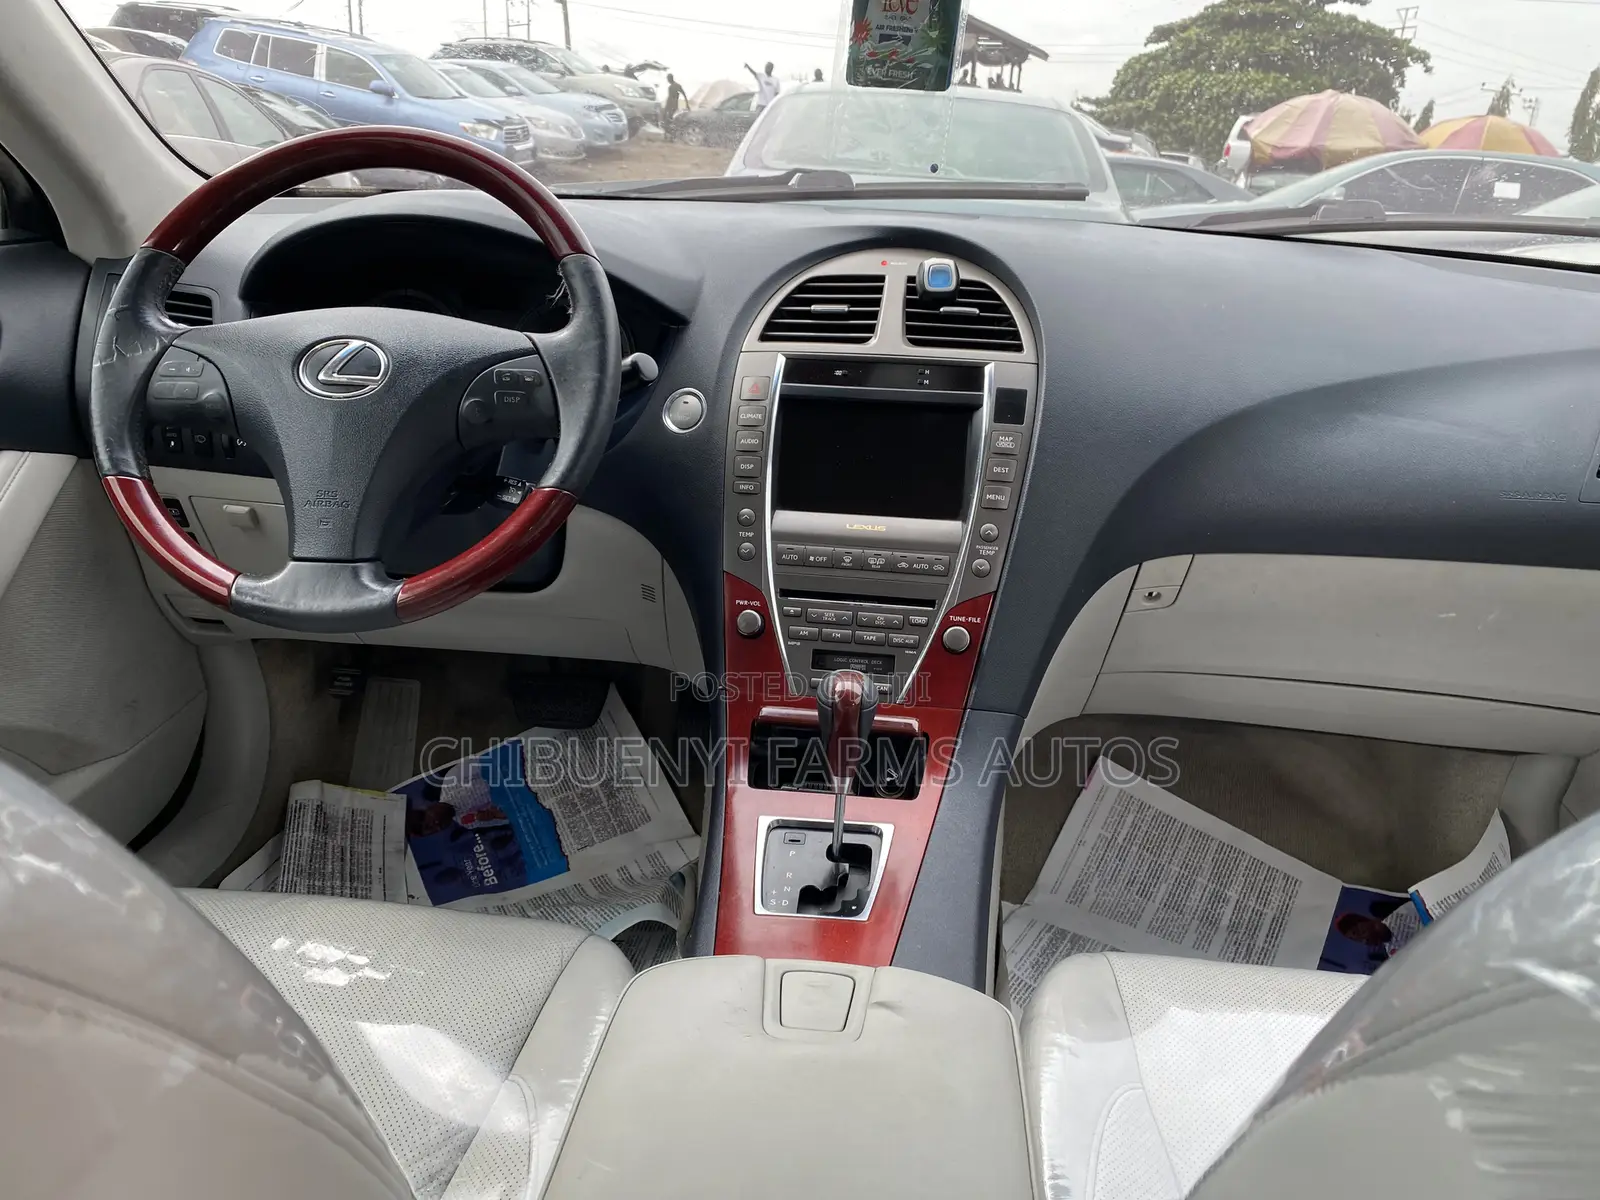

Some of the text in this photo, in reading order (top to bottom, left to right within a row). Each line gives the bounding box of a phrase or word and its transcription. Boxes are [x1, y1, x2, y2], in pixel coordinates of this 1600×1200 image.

[316, 489, 339, 500] SRS
[986, 493, 1006, 501] MENU
[303, 500, 351, 509] AIRBAG
[846, 523, 886, 531] LEXUS
